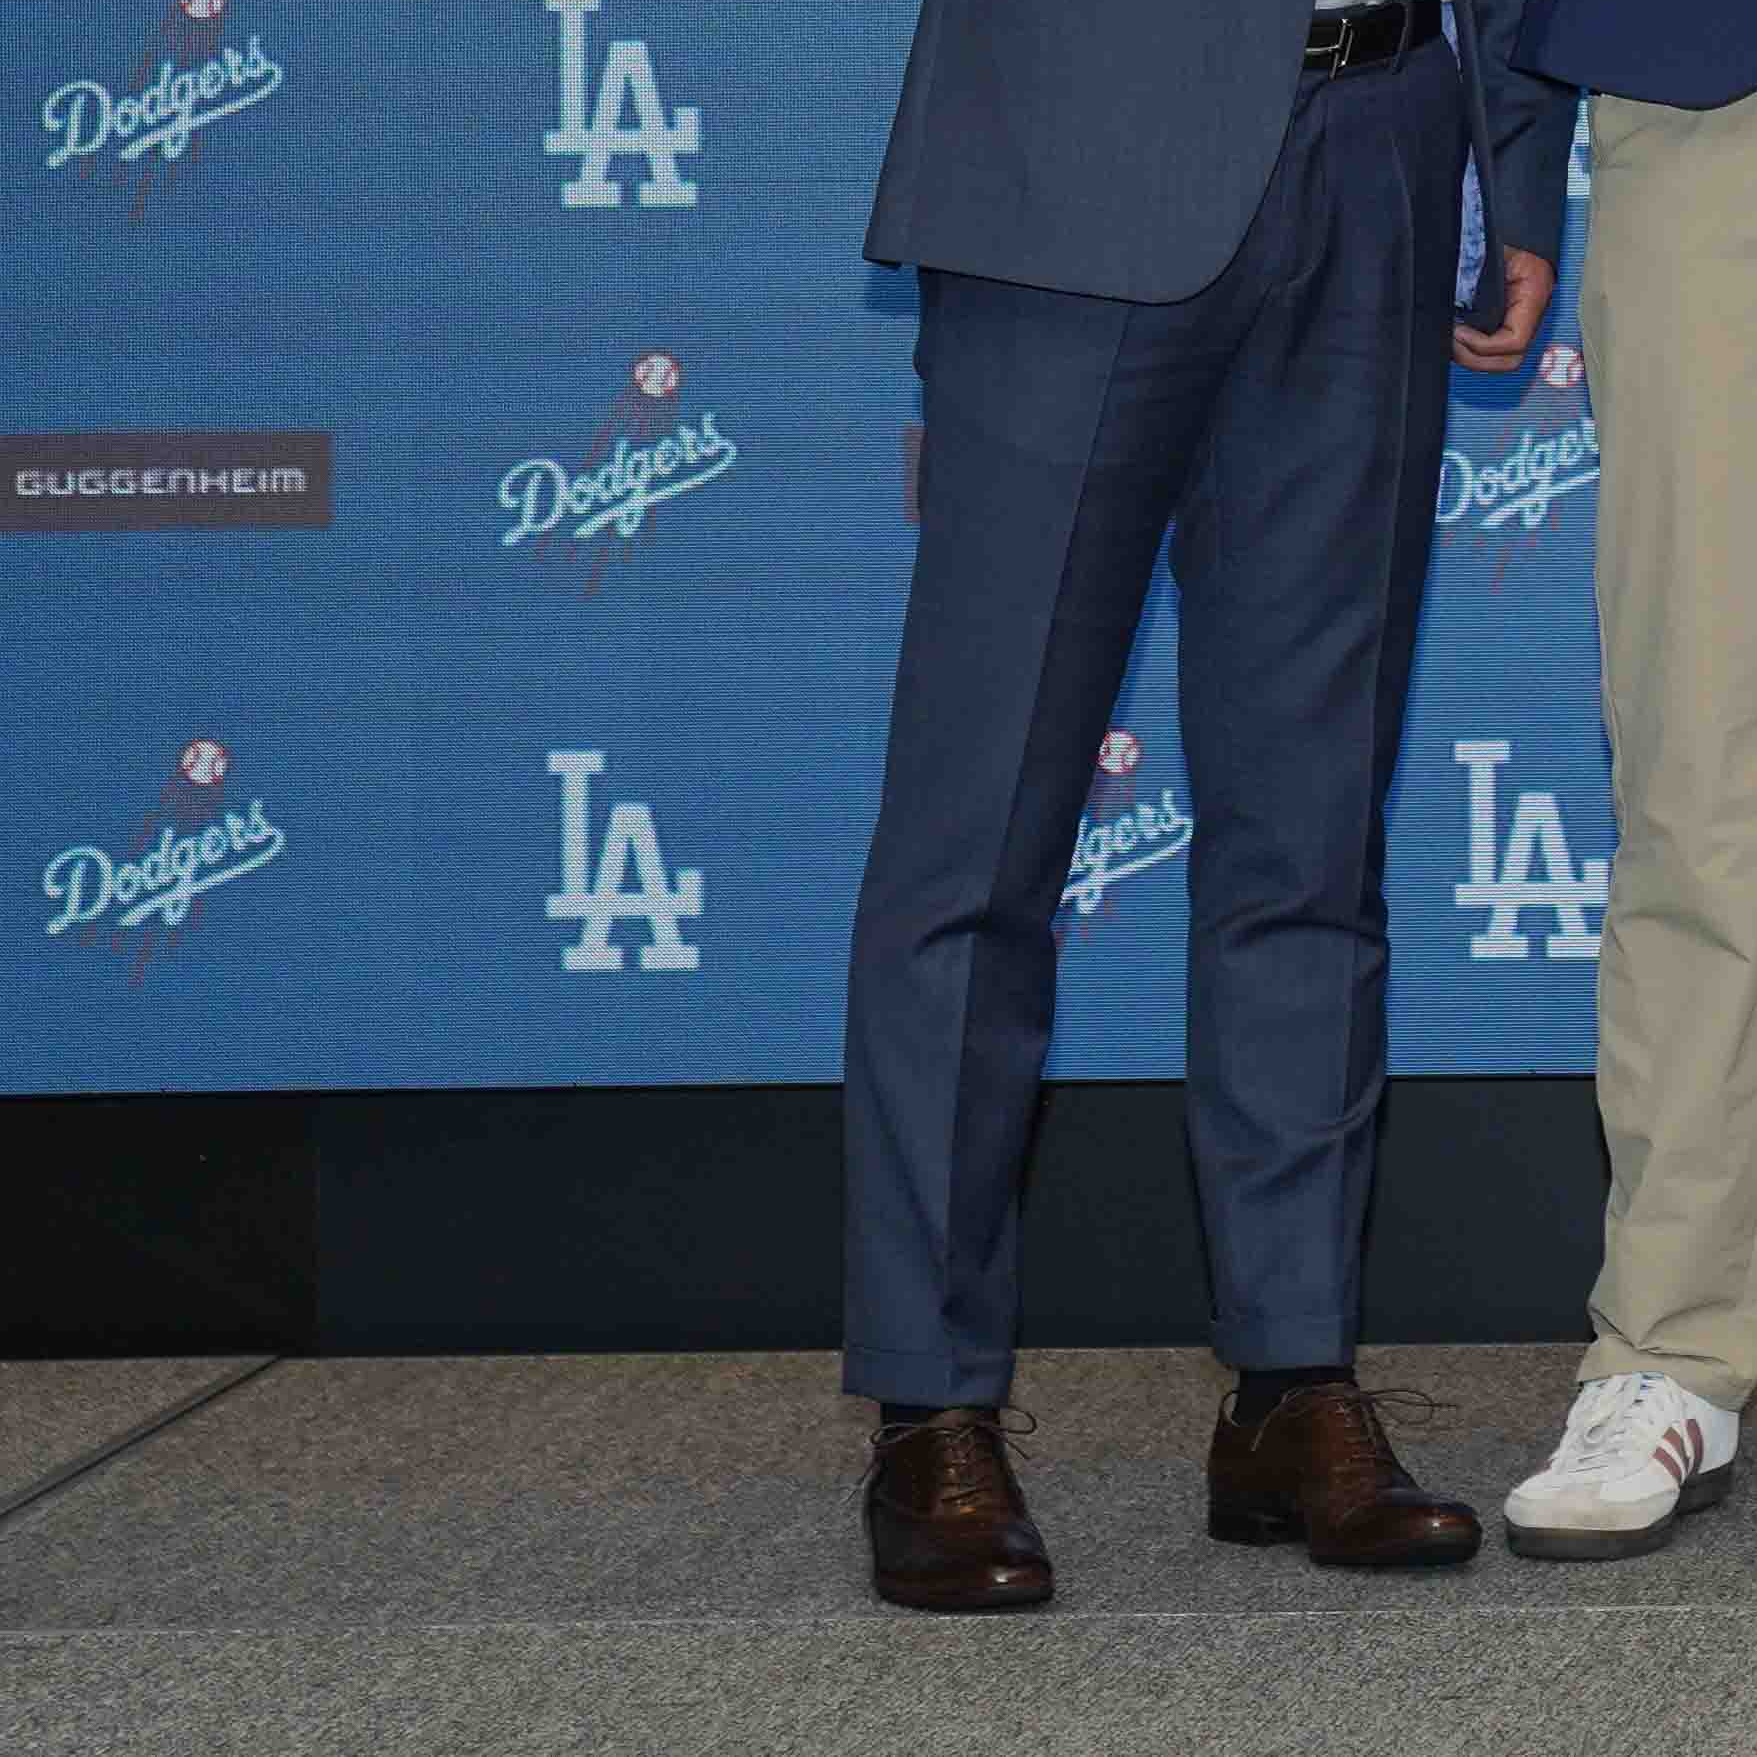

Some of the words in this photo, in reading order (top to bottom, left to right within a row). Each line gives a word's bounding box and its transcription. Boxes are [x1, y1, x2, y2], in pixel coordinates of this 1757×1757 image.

[44, 39, 281, 166] Dodgers
[15, 467, 306, 496] GUGGENHEIM
[500, 417, 734, 544] Dodgers
[1436, 419, 1600, 530] Dodger
[45, 803, 283, 934] Dodgers
[548, 752, 701, 970] LA
[1455, 740, 1609, 960] LA
